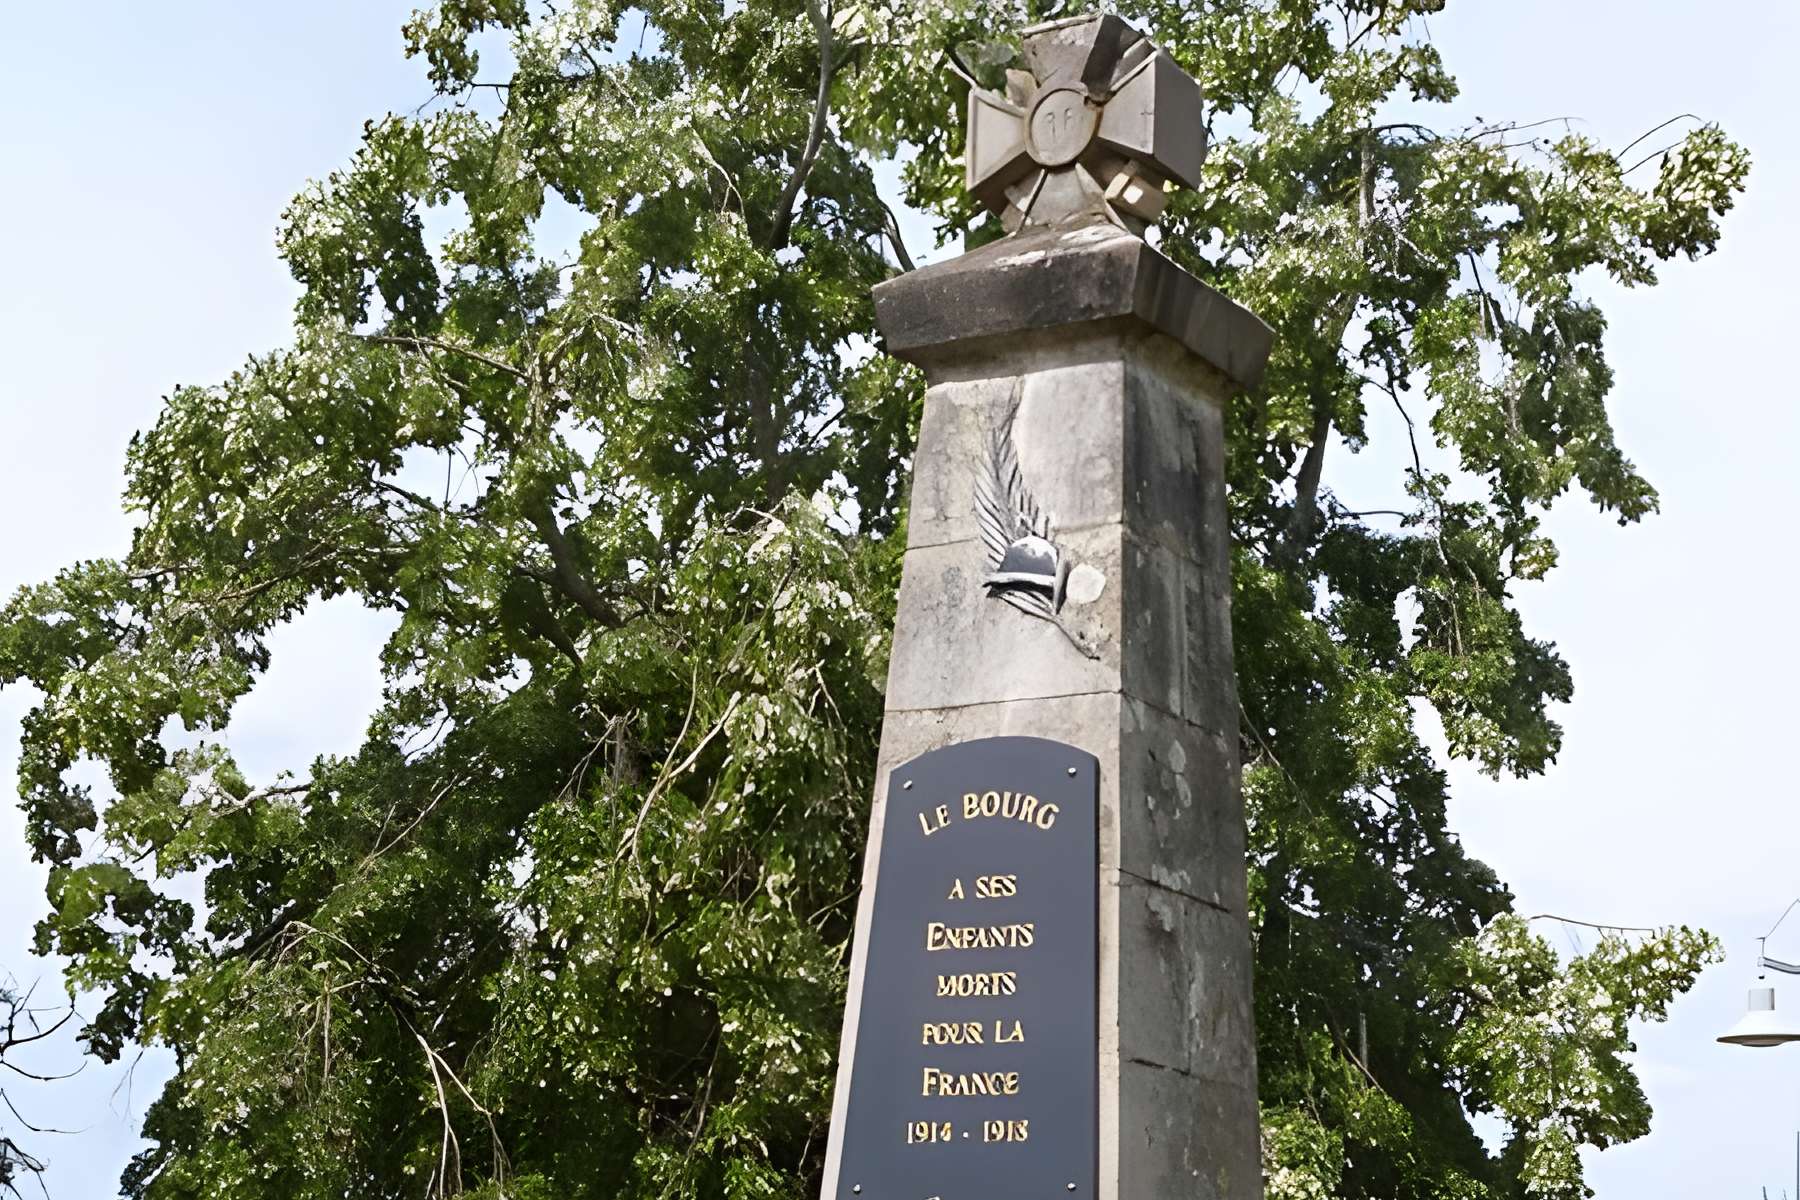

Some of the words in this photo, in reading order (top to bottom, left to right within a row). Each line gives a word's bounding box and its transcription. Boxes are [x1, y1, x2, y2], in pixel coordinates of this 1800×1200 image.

[919, 804, 951, 836] LE
[963, 791, 1060, 830] BOURG
[948, 878, 965, 900] A
[976, 874, 1017, 899] SES
[927, 922, 1034, 951] ENFANTS
[937, 971, 1017, 997] MORTS
[922, 1022, 984, 1045] POUR
[994, 1020, 1025, 1043] LA
[922, 1067, 1019, 1096] FRANCE
[983, 1119, 1029, 1142] 1918
